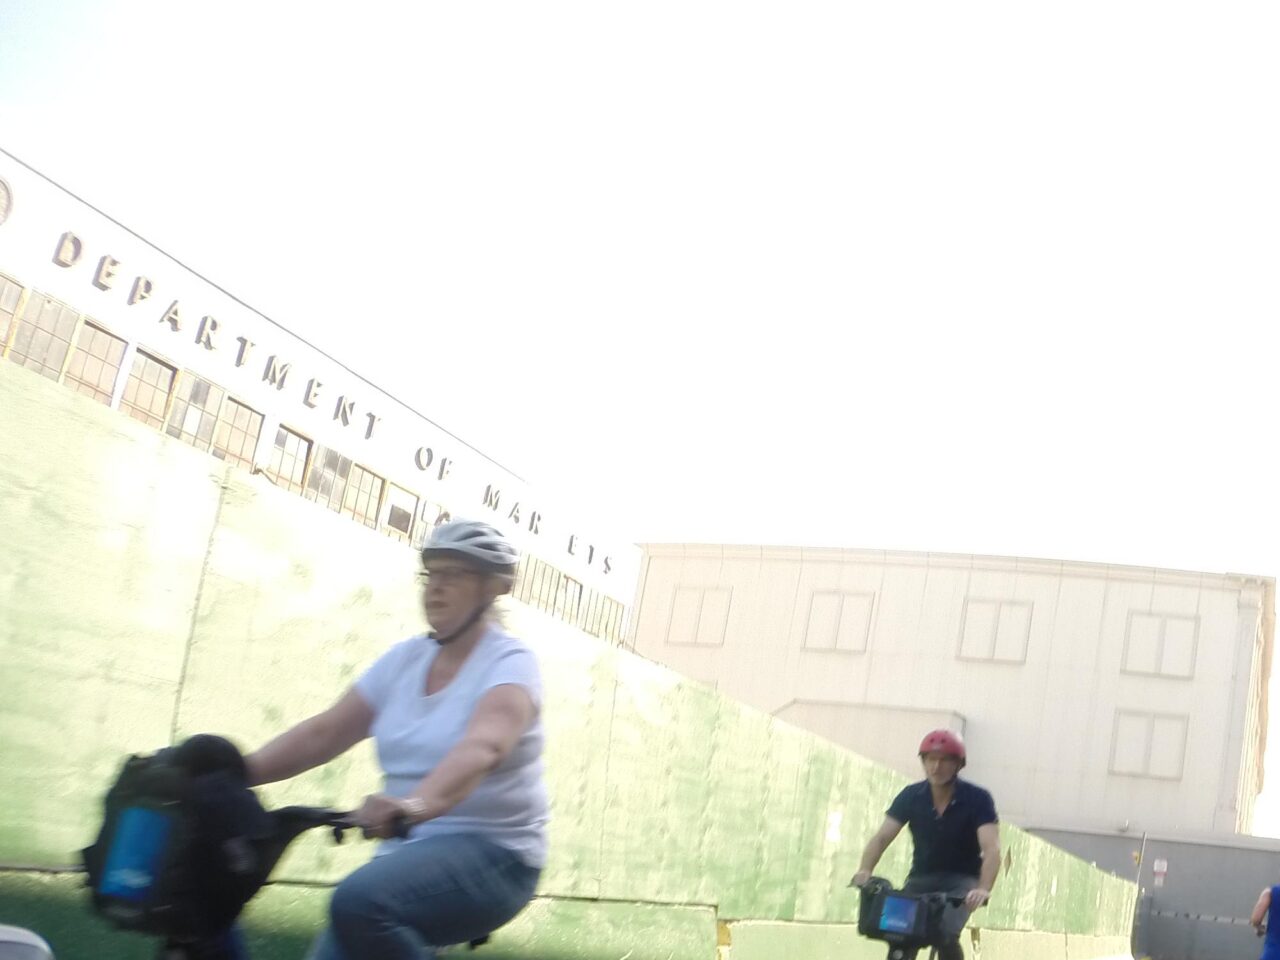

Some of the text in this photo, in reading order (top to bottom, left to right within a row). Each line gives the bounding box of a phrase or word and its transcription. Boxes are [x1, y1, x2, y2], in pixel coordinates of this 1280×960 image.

[52, 230, 613, 576] DEPARTMENT OF MARETS
